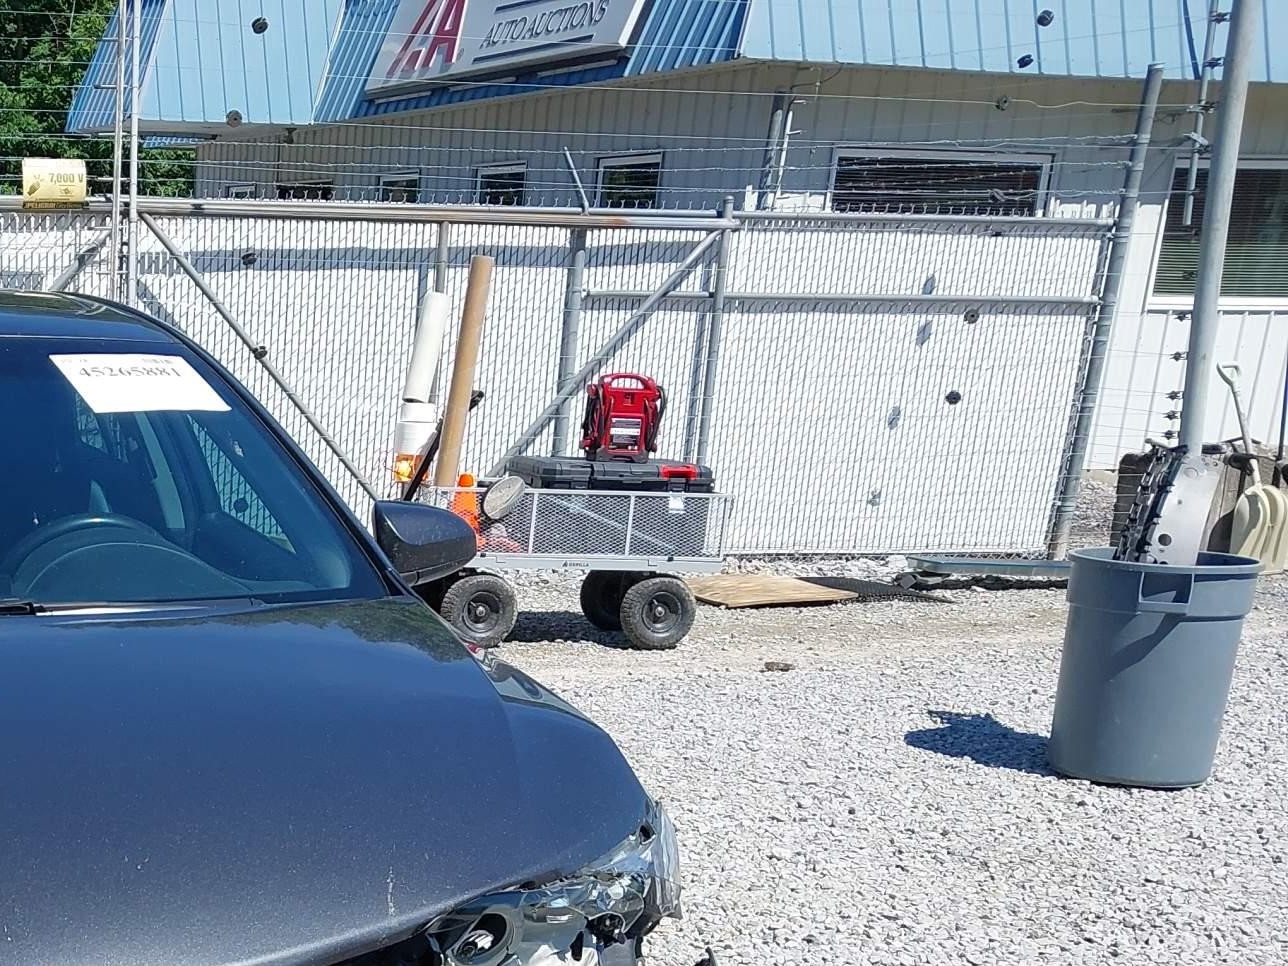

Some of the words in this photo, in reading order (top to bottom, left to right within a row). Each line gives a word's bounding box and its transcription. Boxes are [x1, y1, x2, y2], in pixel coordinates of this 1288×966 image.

[479, 16, 528, 49] AUTO
[522, 0, 609, 39] AUCTIONS
[48, 173, 74, 185] 7,000
[78, 173, 84, 183] V
[79, 366, 182, 377] 45265881
